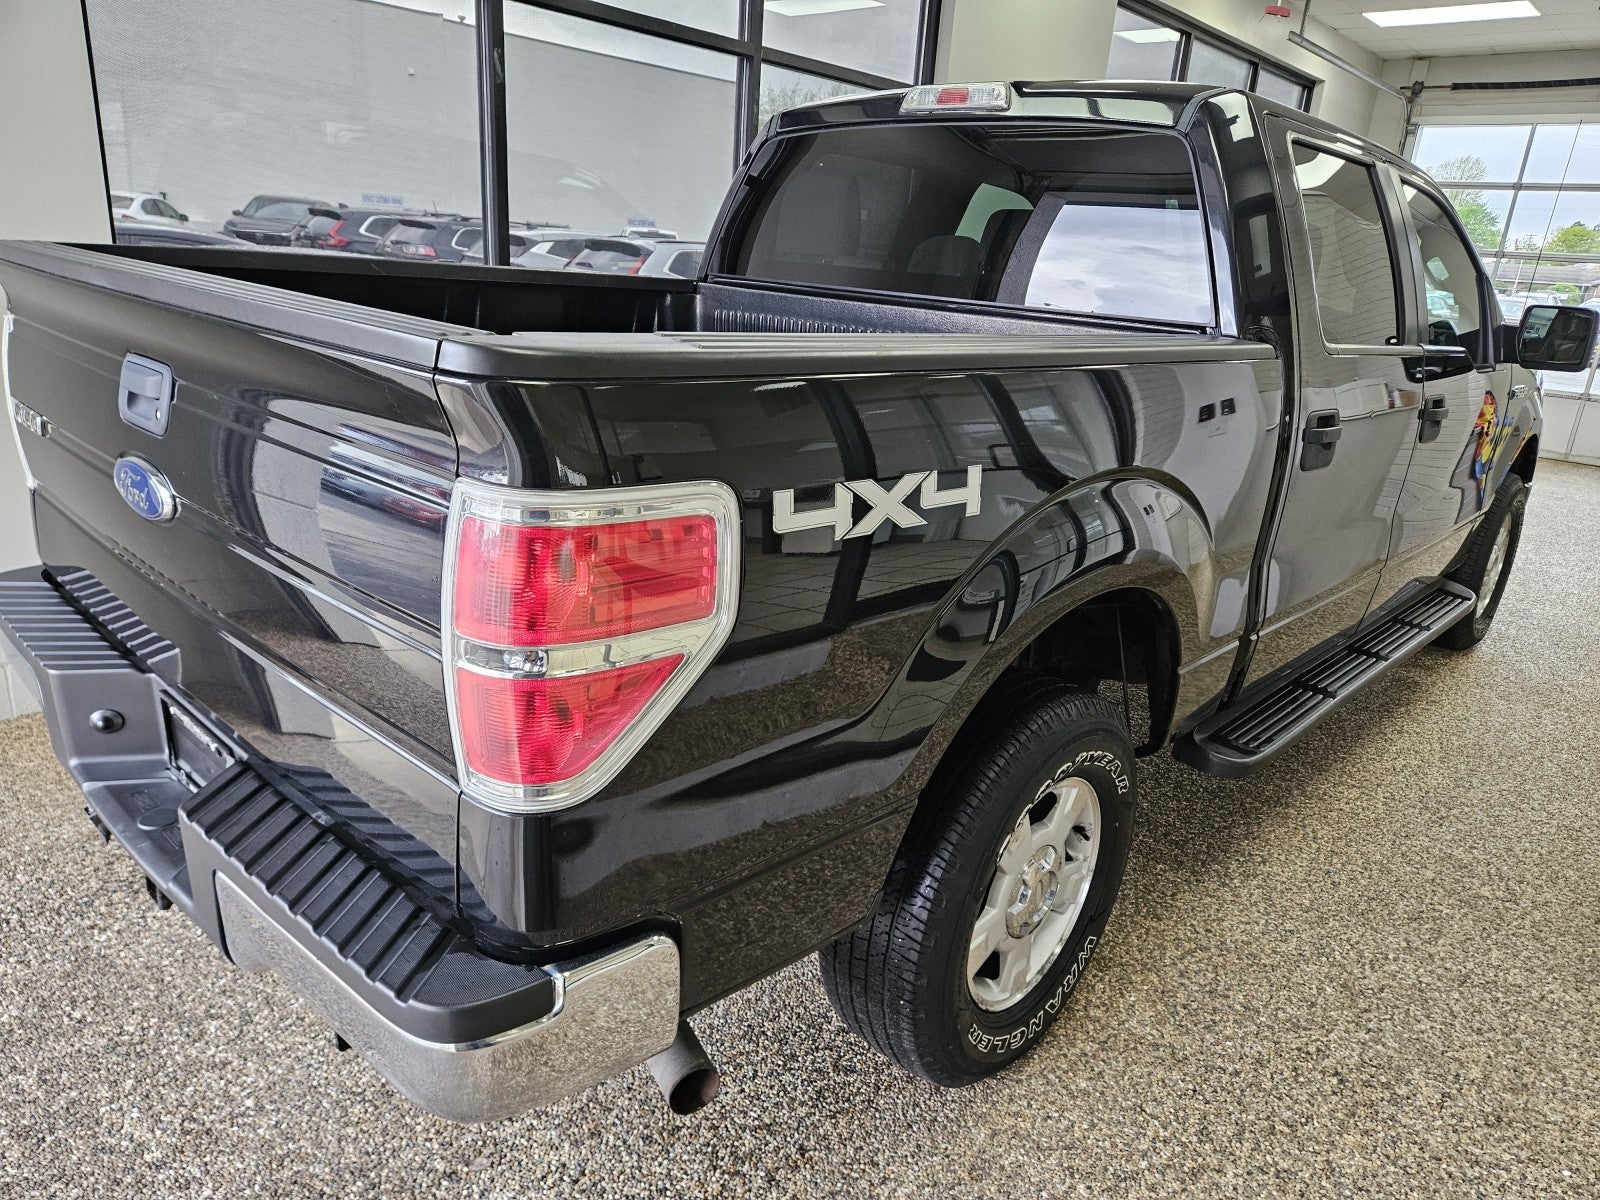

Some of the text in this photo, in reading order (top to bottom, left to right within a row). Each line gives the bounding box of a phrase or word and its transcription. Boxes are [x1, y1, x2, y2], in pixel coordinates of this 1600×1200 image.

[120, 467, 149, 510] Ford
[996, 750, 1130, 866] DYEAR
[968, 936, 1097, 1053] WRANGLER
